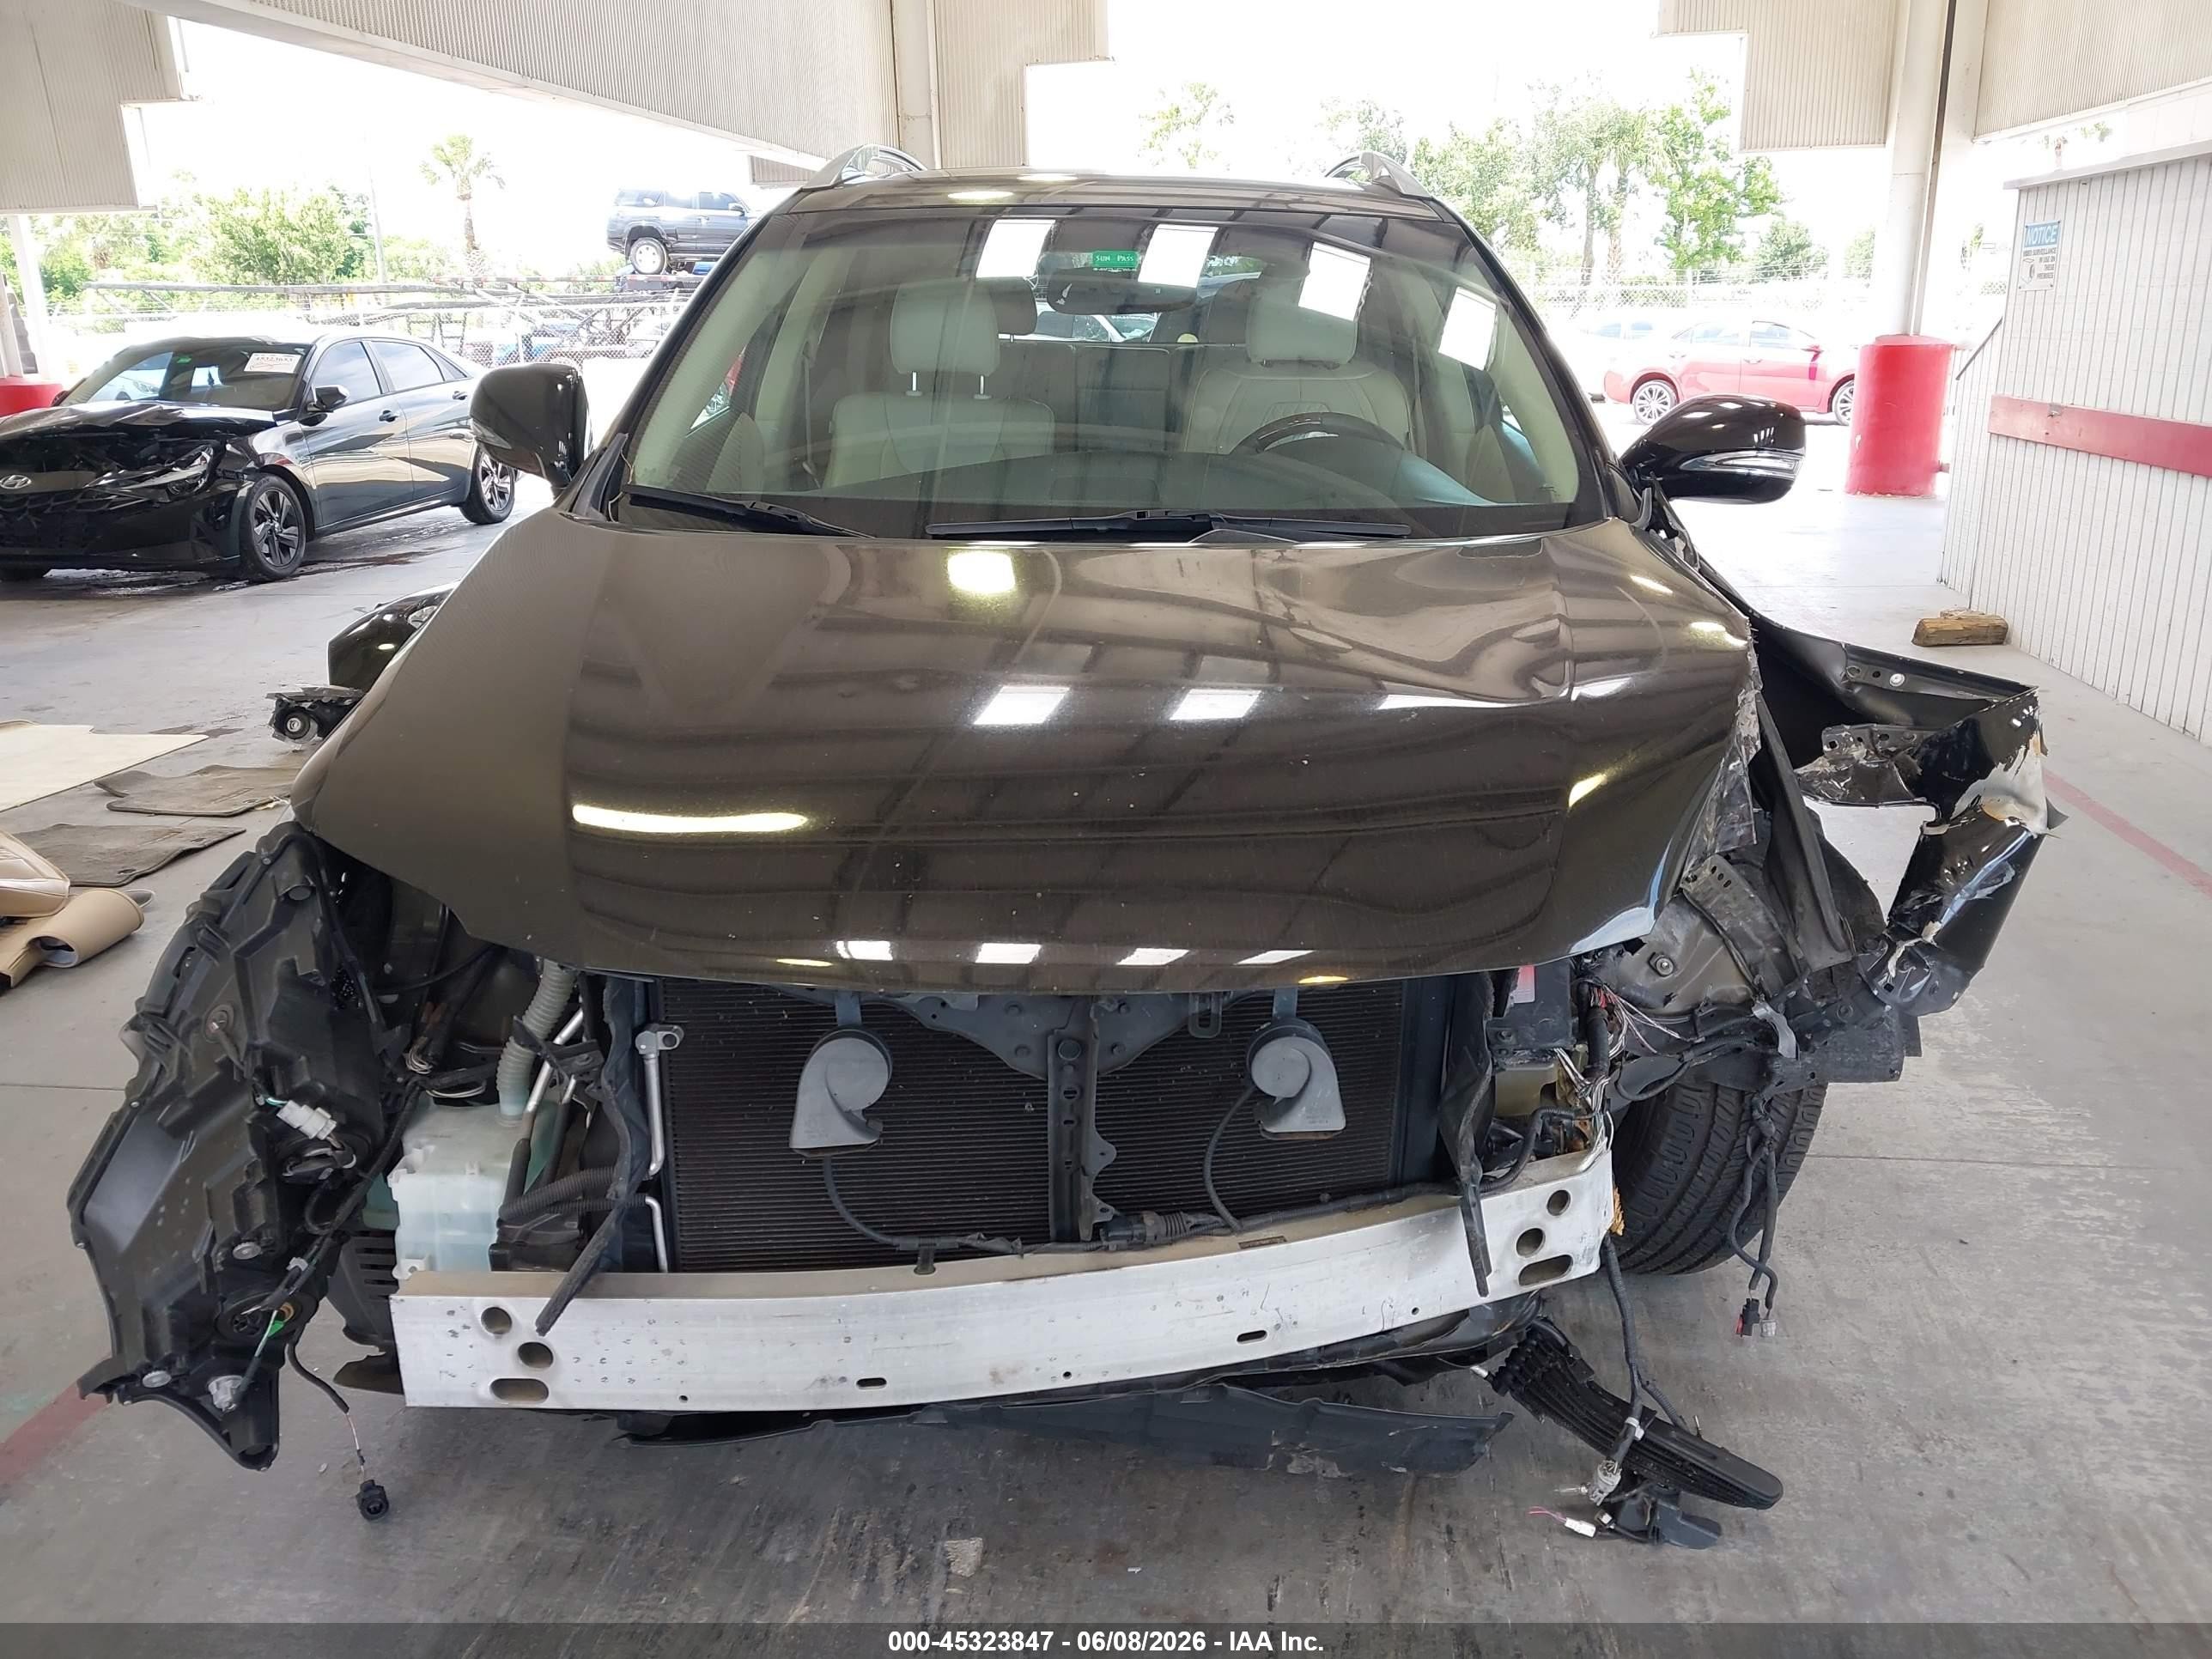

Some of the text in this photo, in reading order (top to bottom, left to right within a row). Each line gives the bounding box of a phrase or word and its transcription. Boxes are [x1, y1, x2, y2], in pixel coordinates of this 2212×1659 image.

[2026, 225, 2058, 246] NOTICE
[1096, 253, 1134, 262] SUN PASS
